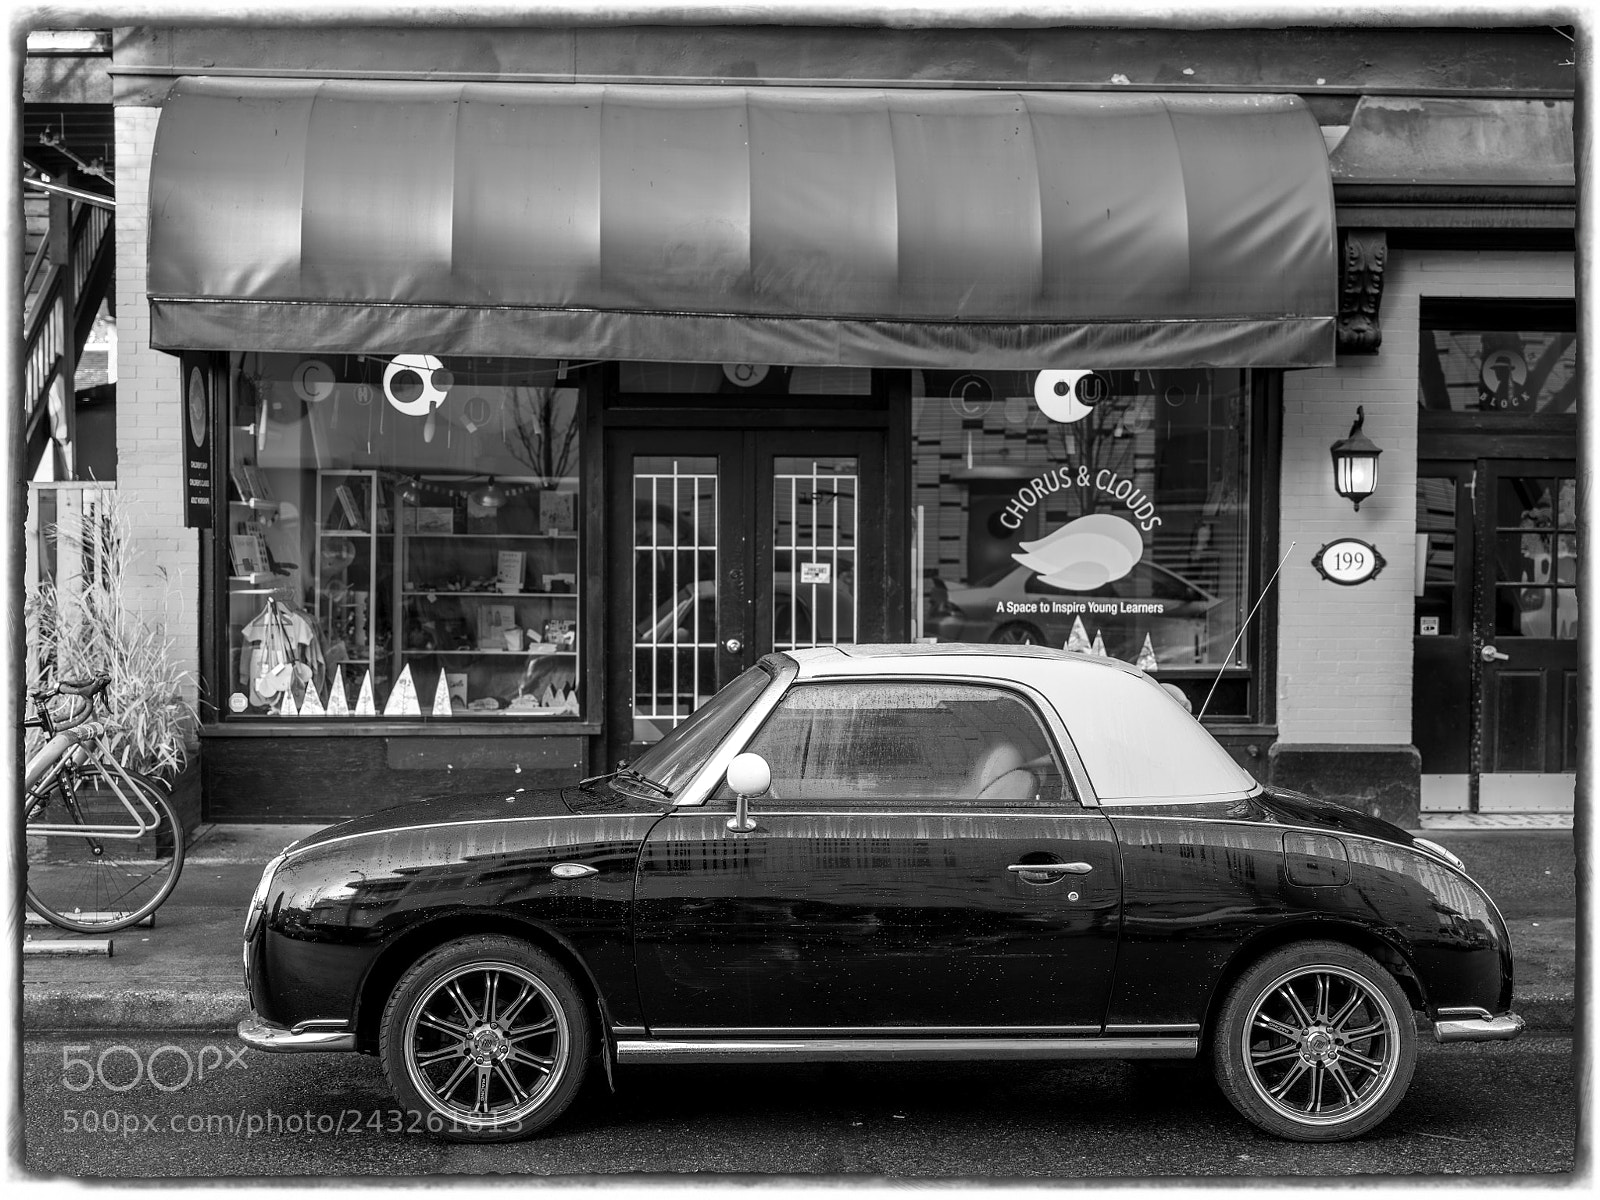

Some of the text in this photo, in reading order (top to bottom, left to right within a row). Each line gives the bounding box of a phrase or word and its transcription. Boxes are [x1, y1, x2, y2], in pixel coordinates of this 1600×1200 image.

[303, 366, 320, 397] C
[961, 381, 981, 413] C
[1080, 378, 1101, 403] U
[1479, 392, 1530, 409] BLOCK
[1000, 465, 1162, 531] CHORUS & CLOUDS
[1334, 552, 1364, 571] 199
[996, 601, 1164, 615] A Space to Inspire Young Learners
